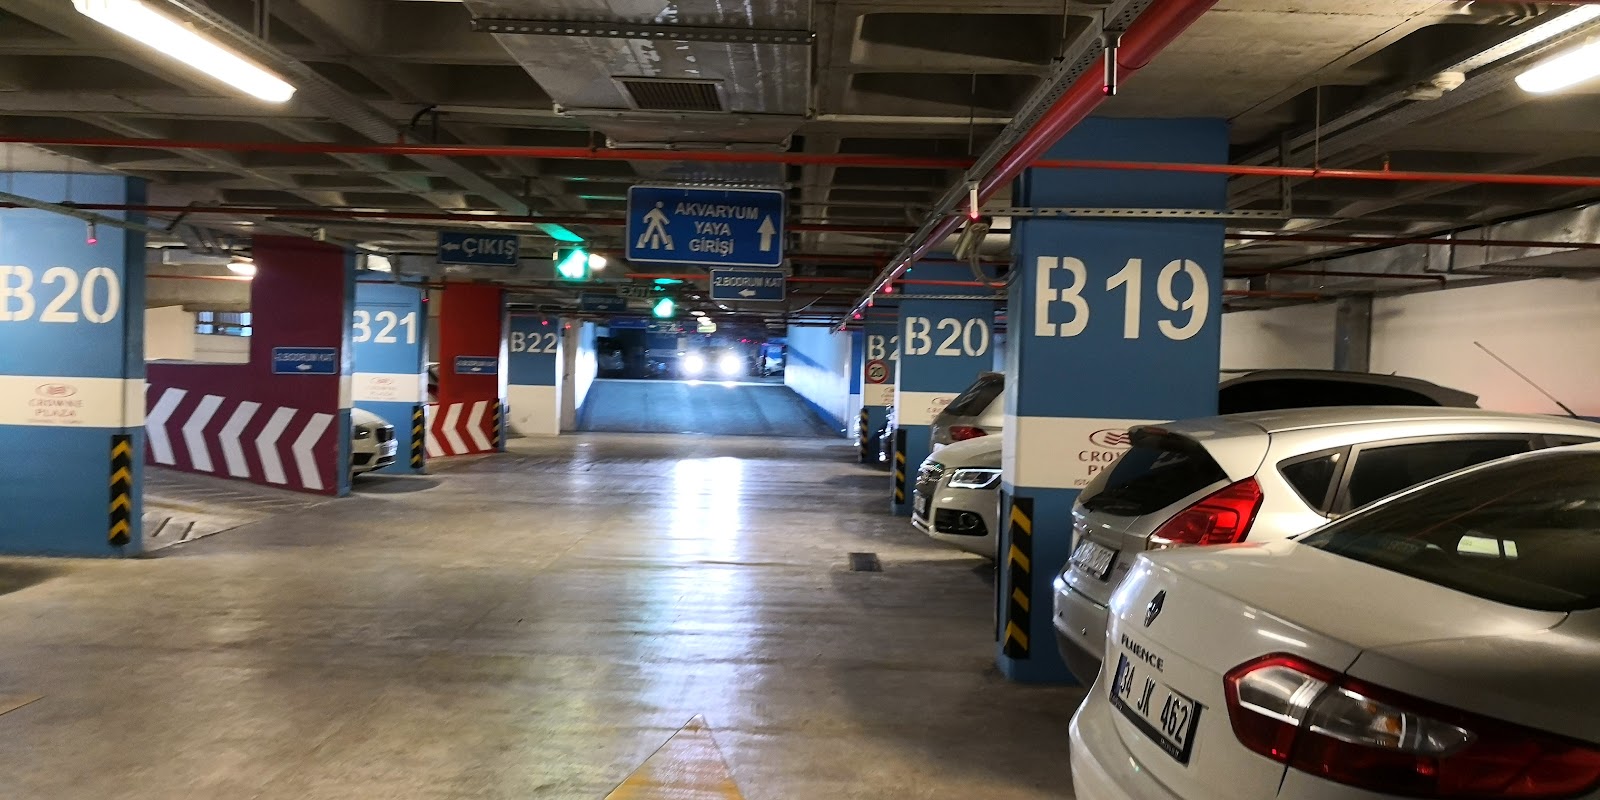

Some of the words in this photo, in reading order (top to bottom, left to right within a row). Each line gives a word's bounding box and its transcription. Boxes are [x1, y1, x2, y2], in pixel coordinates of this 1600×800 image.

[674, 202, 759, 220] AKVARYUM
[695, 221, 731, 236] YAYA
[462, 237, 516, 259] ÇIKIŞ
[688, 238, 734, 257] GİRİŞİ
[765, 277, 783, 287] KAT
[1034, 256, 1210, 341] B19
[510, 331, 557, 354] B22
[867, 334, 900, 361] B2
[905, 316, 989, 357] B20
[1078, 450, 1121, 463] CRO
[1121, 633, 1164, 673] FLUENCE
[1119, 664, 1136, 699] 34
[1137, 674, 1156, 718] JK
[1160, 691, 1189, 745] 462
